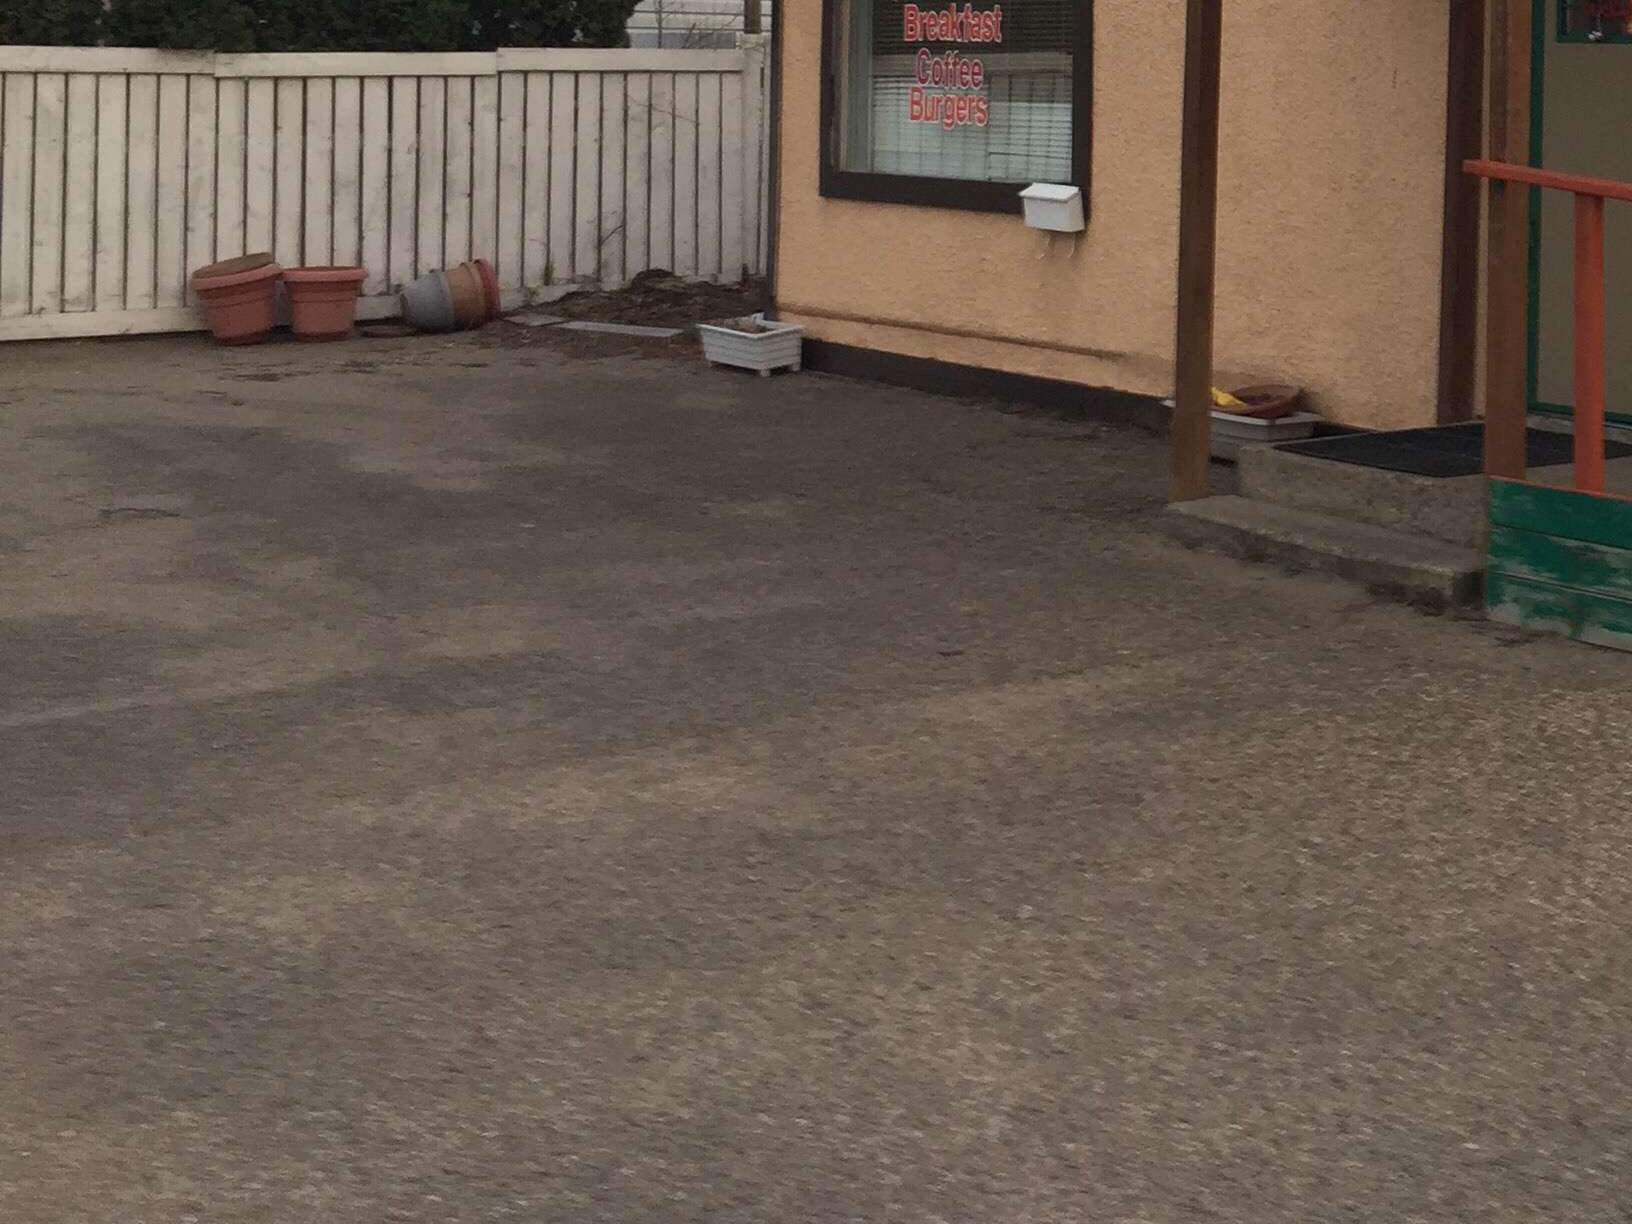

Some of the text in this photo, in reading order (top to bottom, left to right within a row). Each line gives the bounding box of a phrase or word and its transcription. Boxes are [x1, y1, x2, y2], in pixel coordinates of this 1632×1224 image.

[903, 3, 1002, 43] Breakfast
[916, 48, 984, 90] Coffee
[908, 86, 988, 131] Burgers
